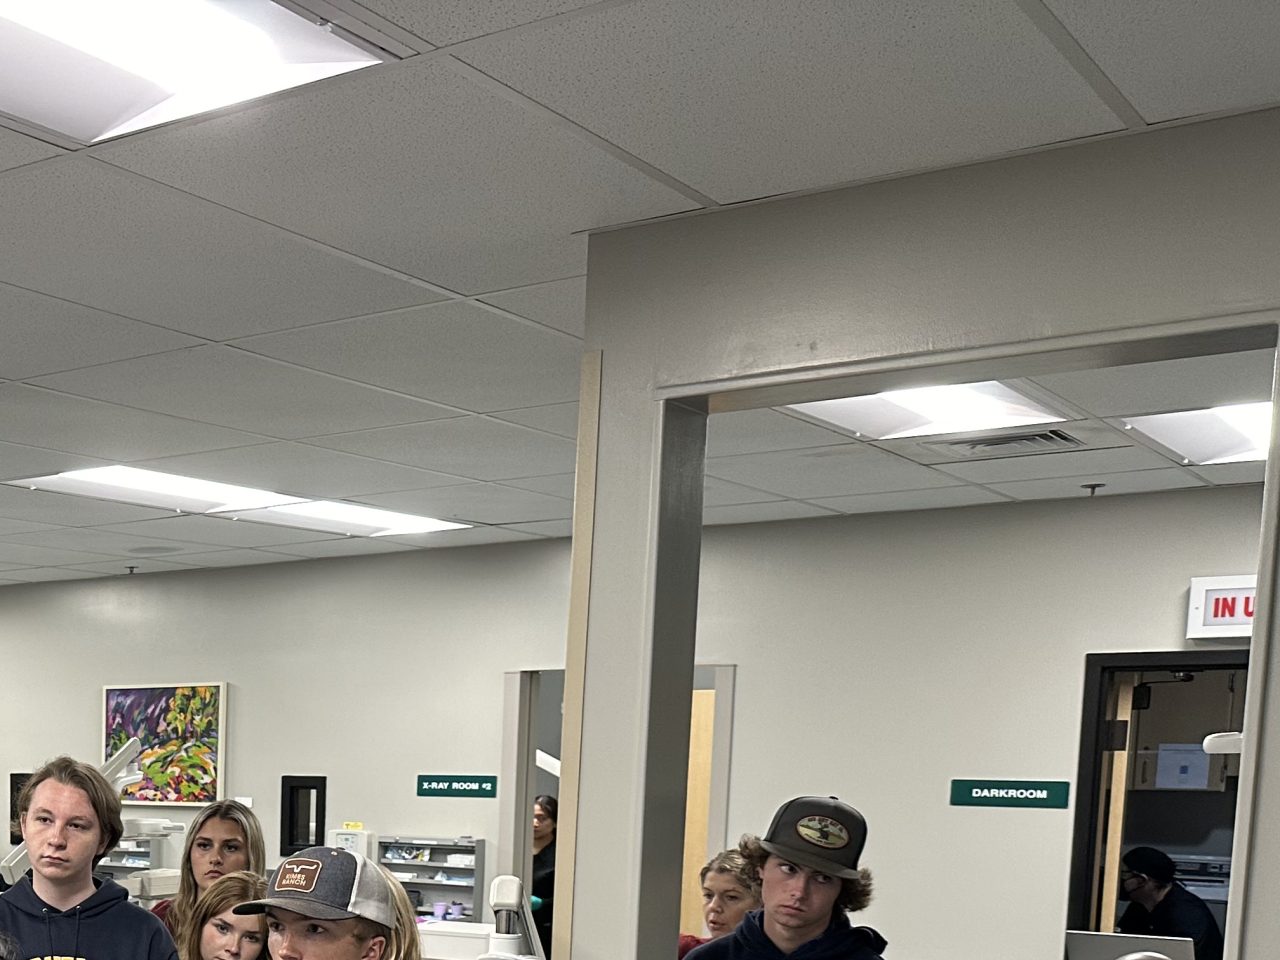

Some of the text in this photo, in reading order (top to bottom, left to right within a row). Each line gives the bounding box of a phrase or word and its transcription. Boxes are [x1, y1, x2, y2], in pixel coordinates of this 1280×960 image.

[1212, 596, 1237, 618] IN
[422, 781, 450, 790] X-RAY
[451, 781, 480, 790] ROOM
[971, 788, 1048, 799] DARKROOM
[281, 878, 307, 887] RANCH
